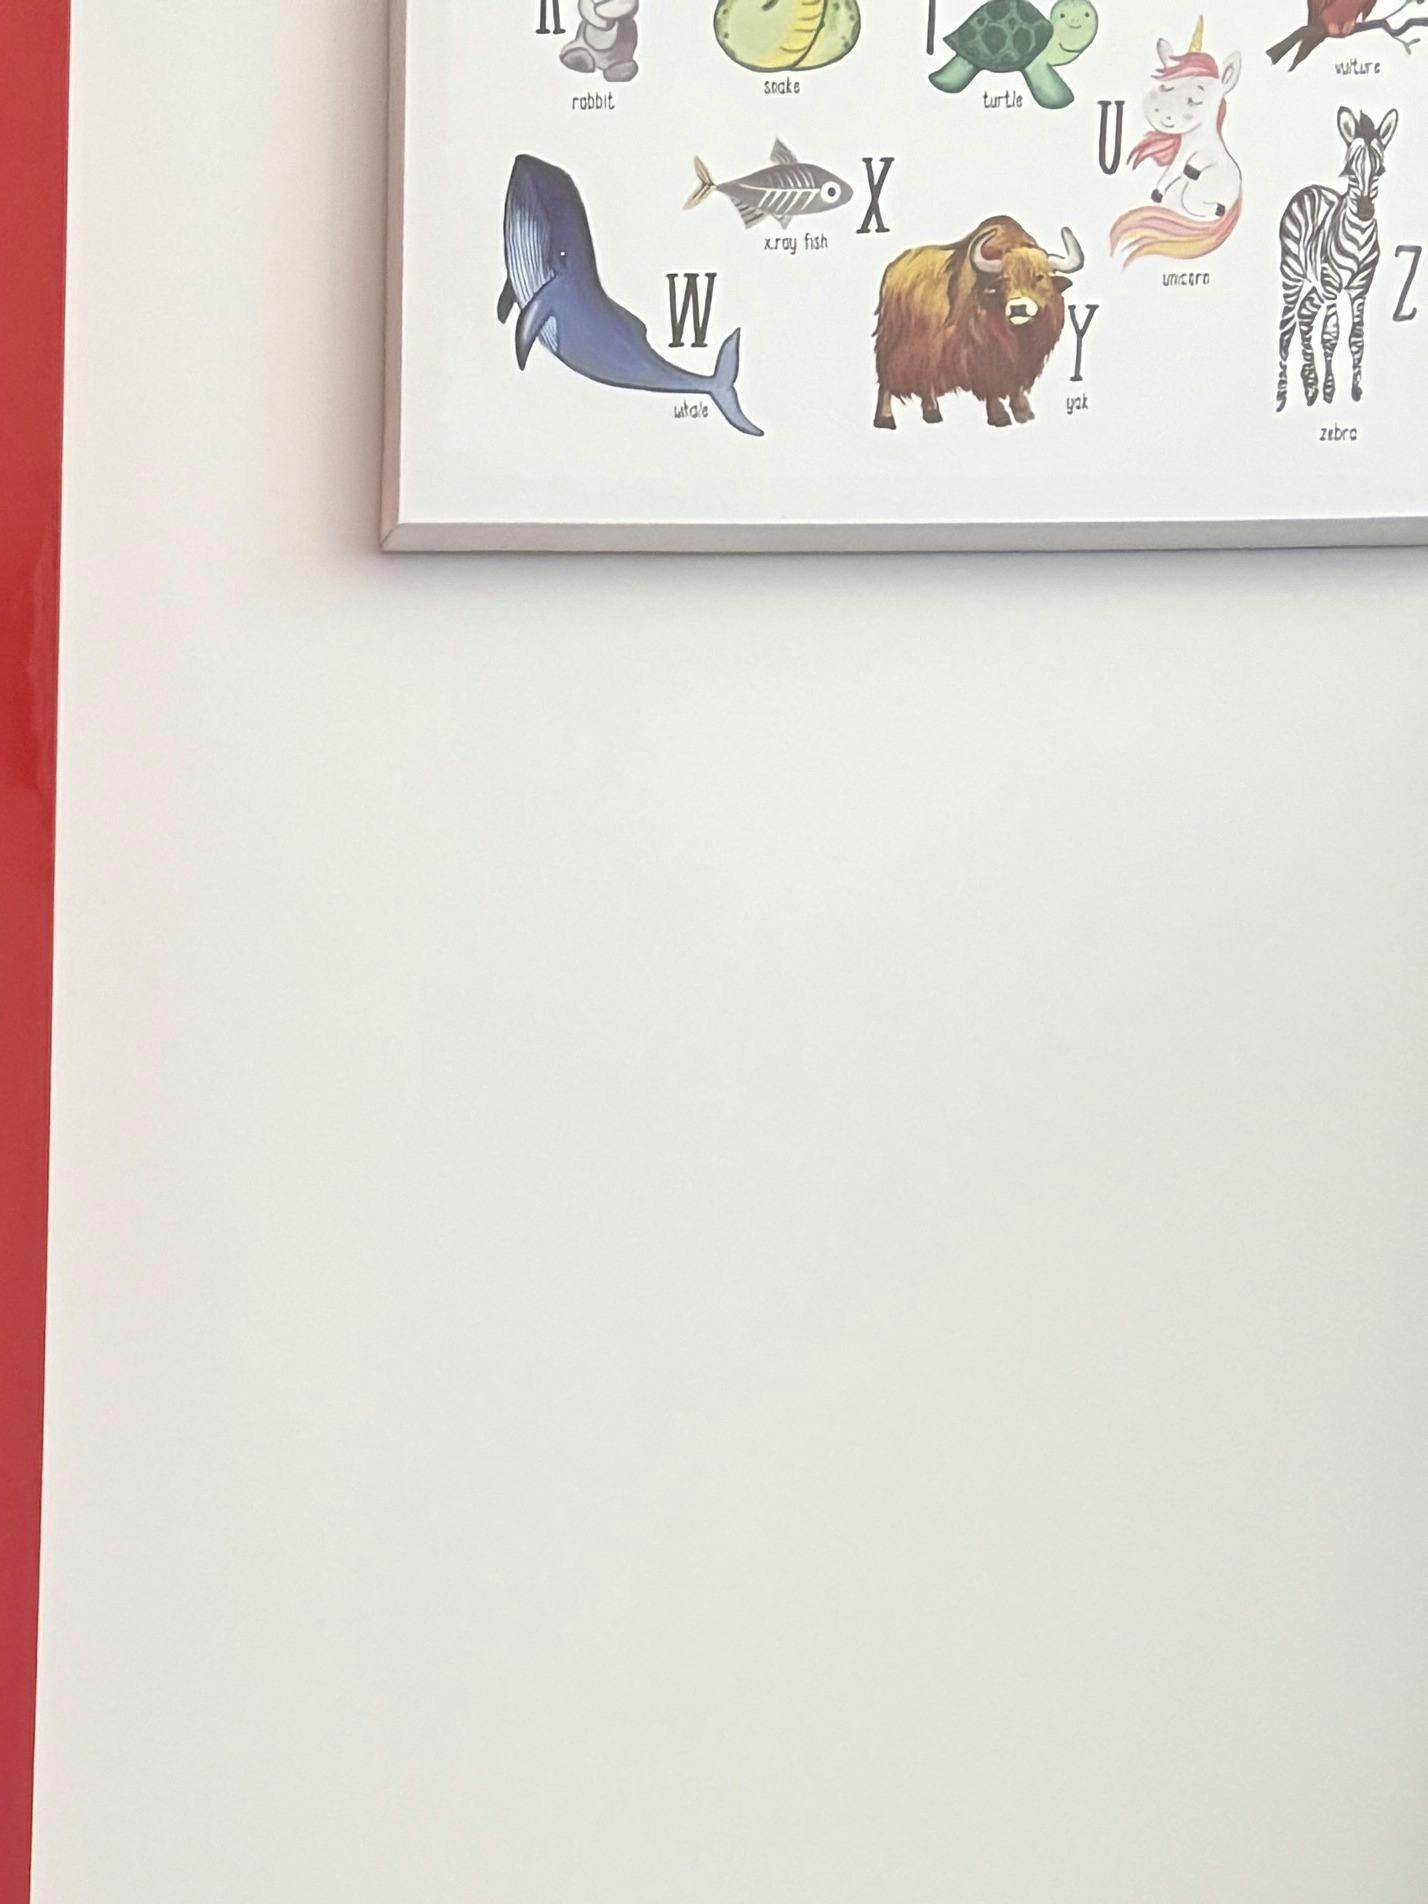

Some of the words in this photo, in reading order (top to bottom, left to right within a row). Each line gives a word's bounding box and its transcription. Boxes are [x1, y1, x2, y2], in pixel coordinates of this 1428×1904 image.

[764, 76, 800, 95] snake
[572, 93, 615, 110] rabbit
[983, 90, 1023, 109] turtle
[1097, 101, 1125, 175] U
[856, 156, 895, 235] X
[804, 232, 828, 250] fish
[1162, 272, 1210, 287] unicorn
[1392, 244, 1423, 322] Z
[665, 272, 717, 348] W
[1068, 304, 1100, 382] Y
[1066, 392, 1089, 414] yak
[1319, 425, 1357, 442] zebra
